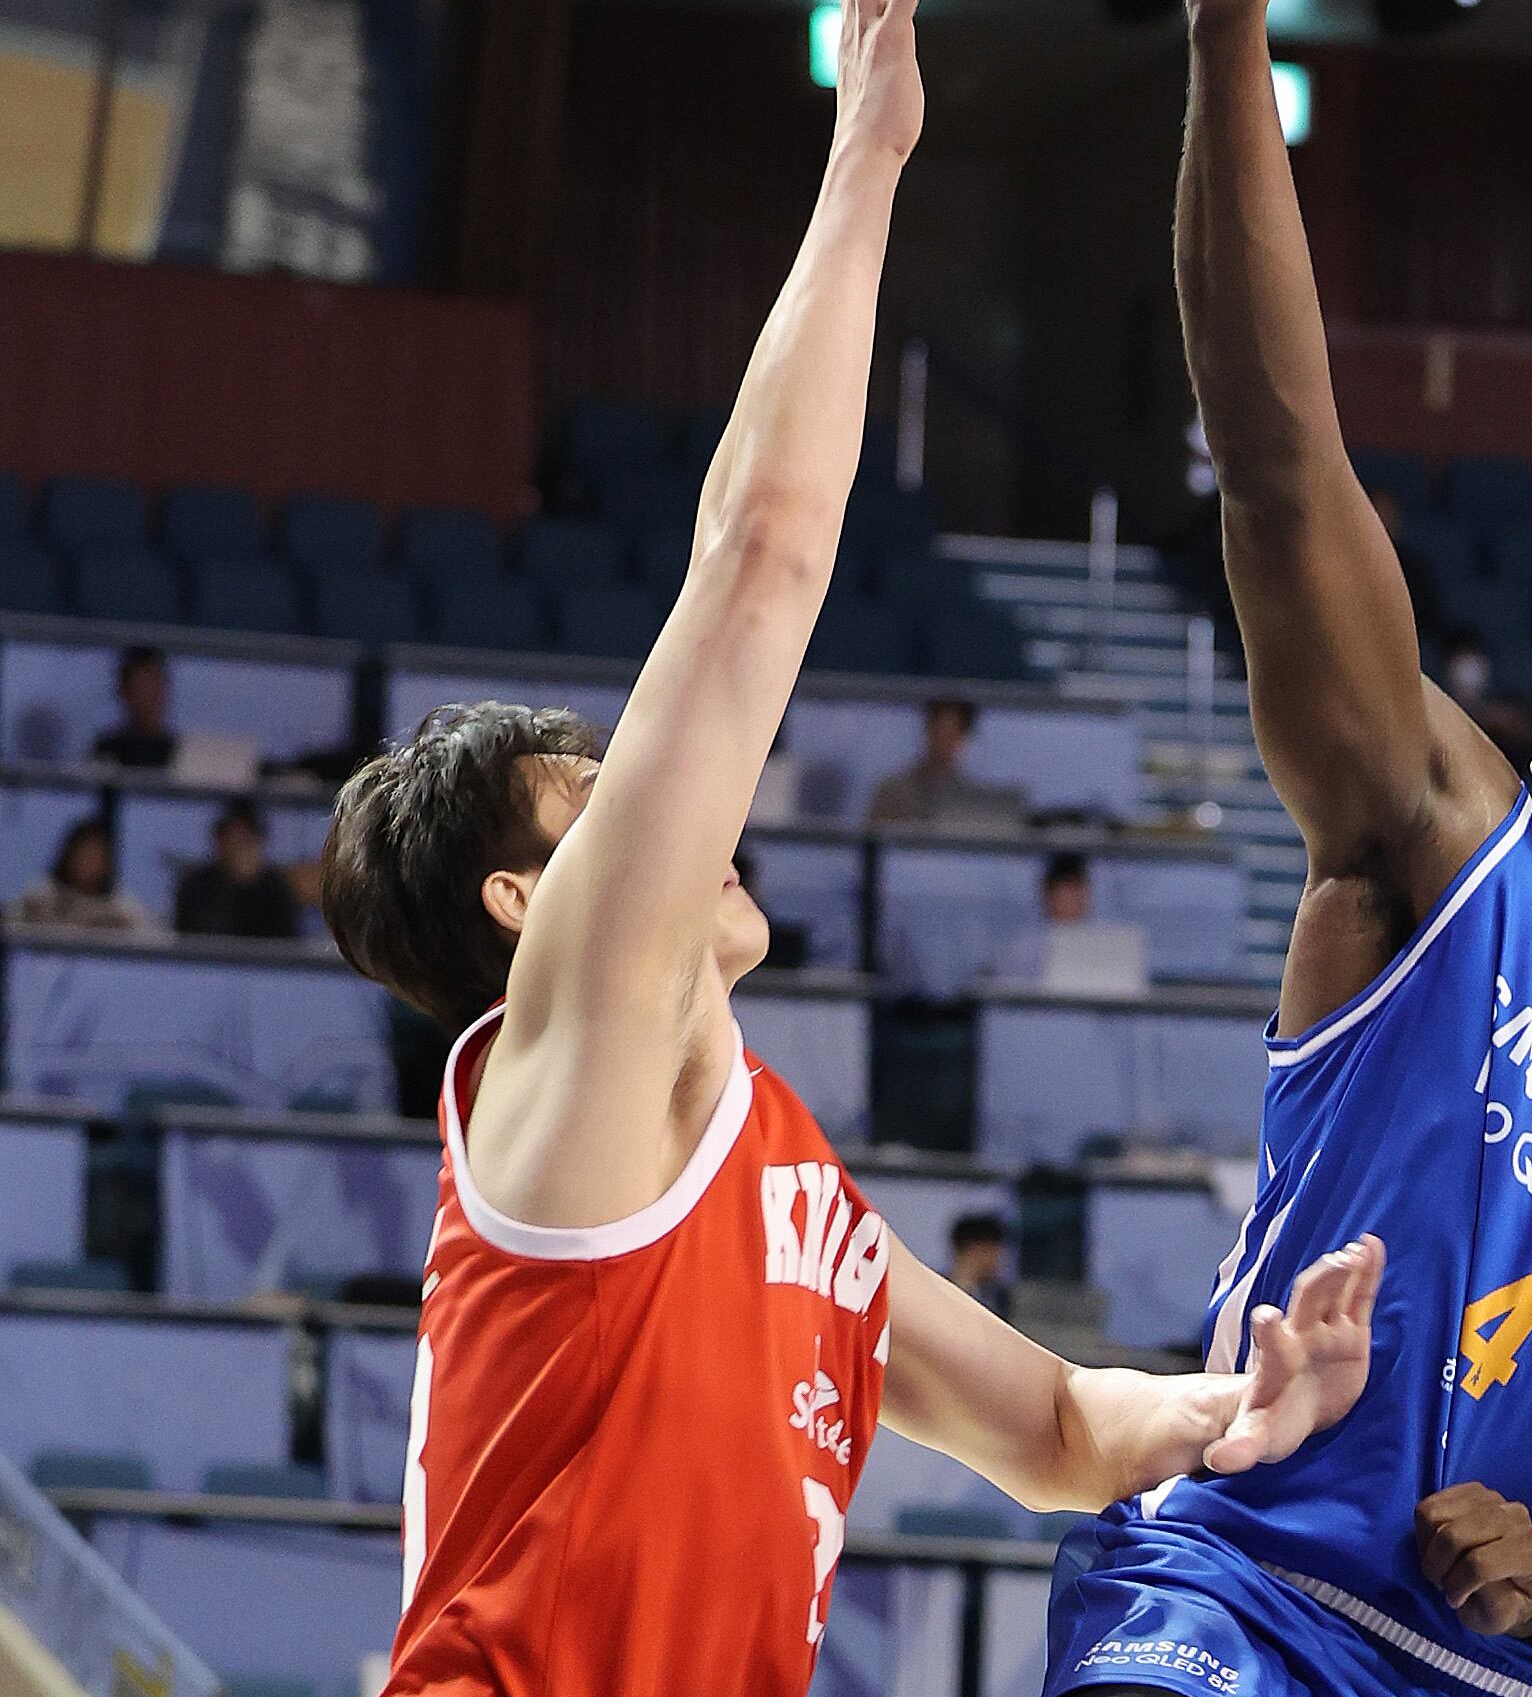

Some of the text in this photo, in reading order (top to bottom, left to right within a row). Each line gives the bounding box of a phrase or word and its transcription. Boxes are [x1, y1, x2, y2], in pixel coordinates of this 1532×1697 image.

[1086, 1640, 1241, 1681] SAMSUNG
[1135, 1653, 1206, 1677] QLED
[1207, 1673, 1242, 1696] 8K
